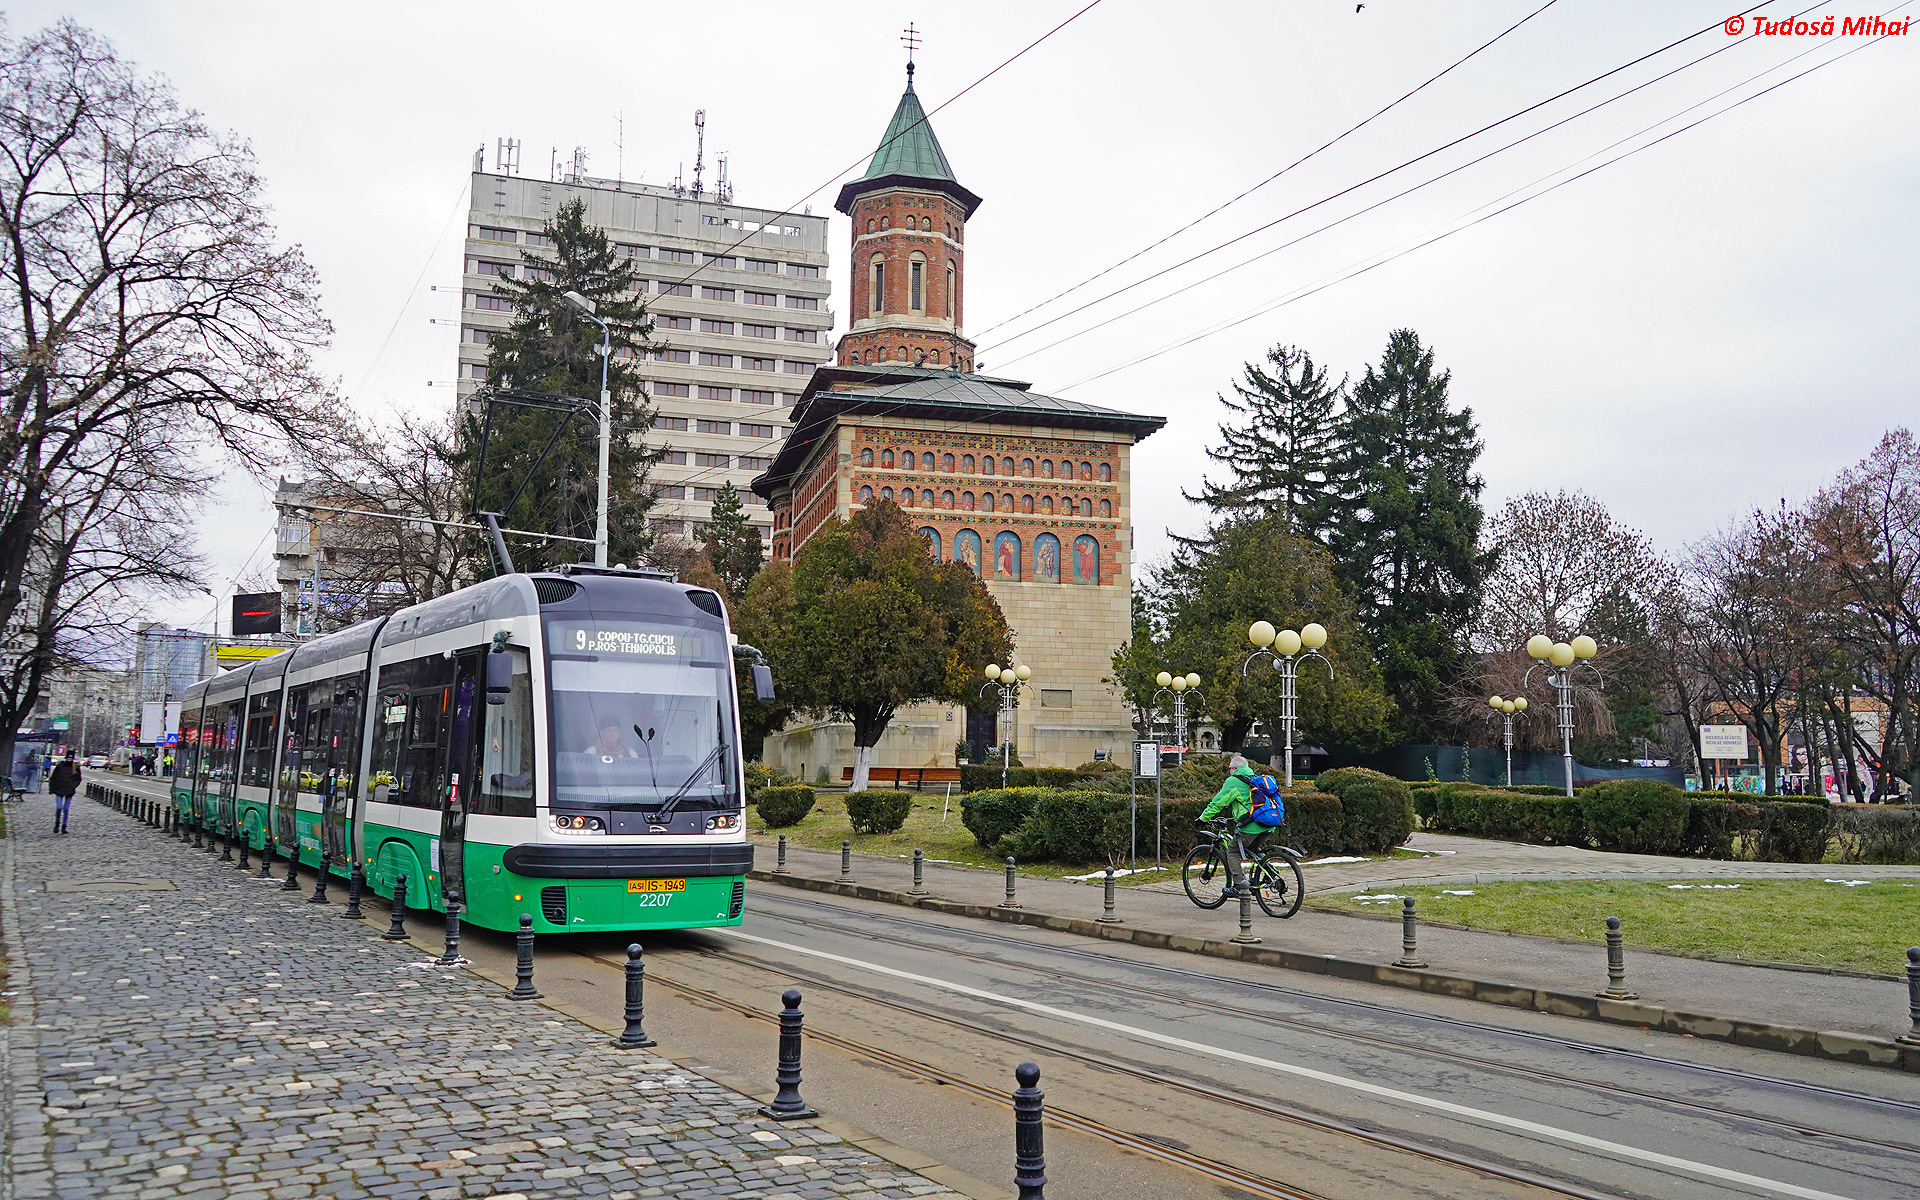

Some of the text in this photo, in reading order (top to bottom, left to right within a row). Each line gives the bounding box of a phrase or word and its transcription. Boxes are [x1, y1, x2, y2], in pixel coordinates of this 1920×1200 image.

[576, 630, 586, 650] 9
[597, 631, 674, 645] COPOU-TG.CUCU
[640, 893, 673, 907] 2207
